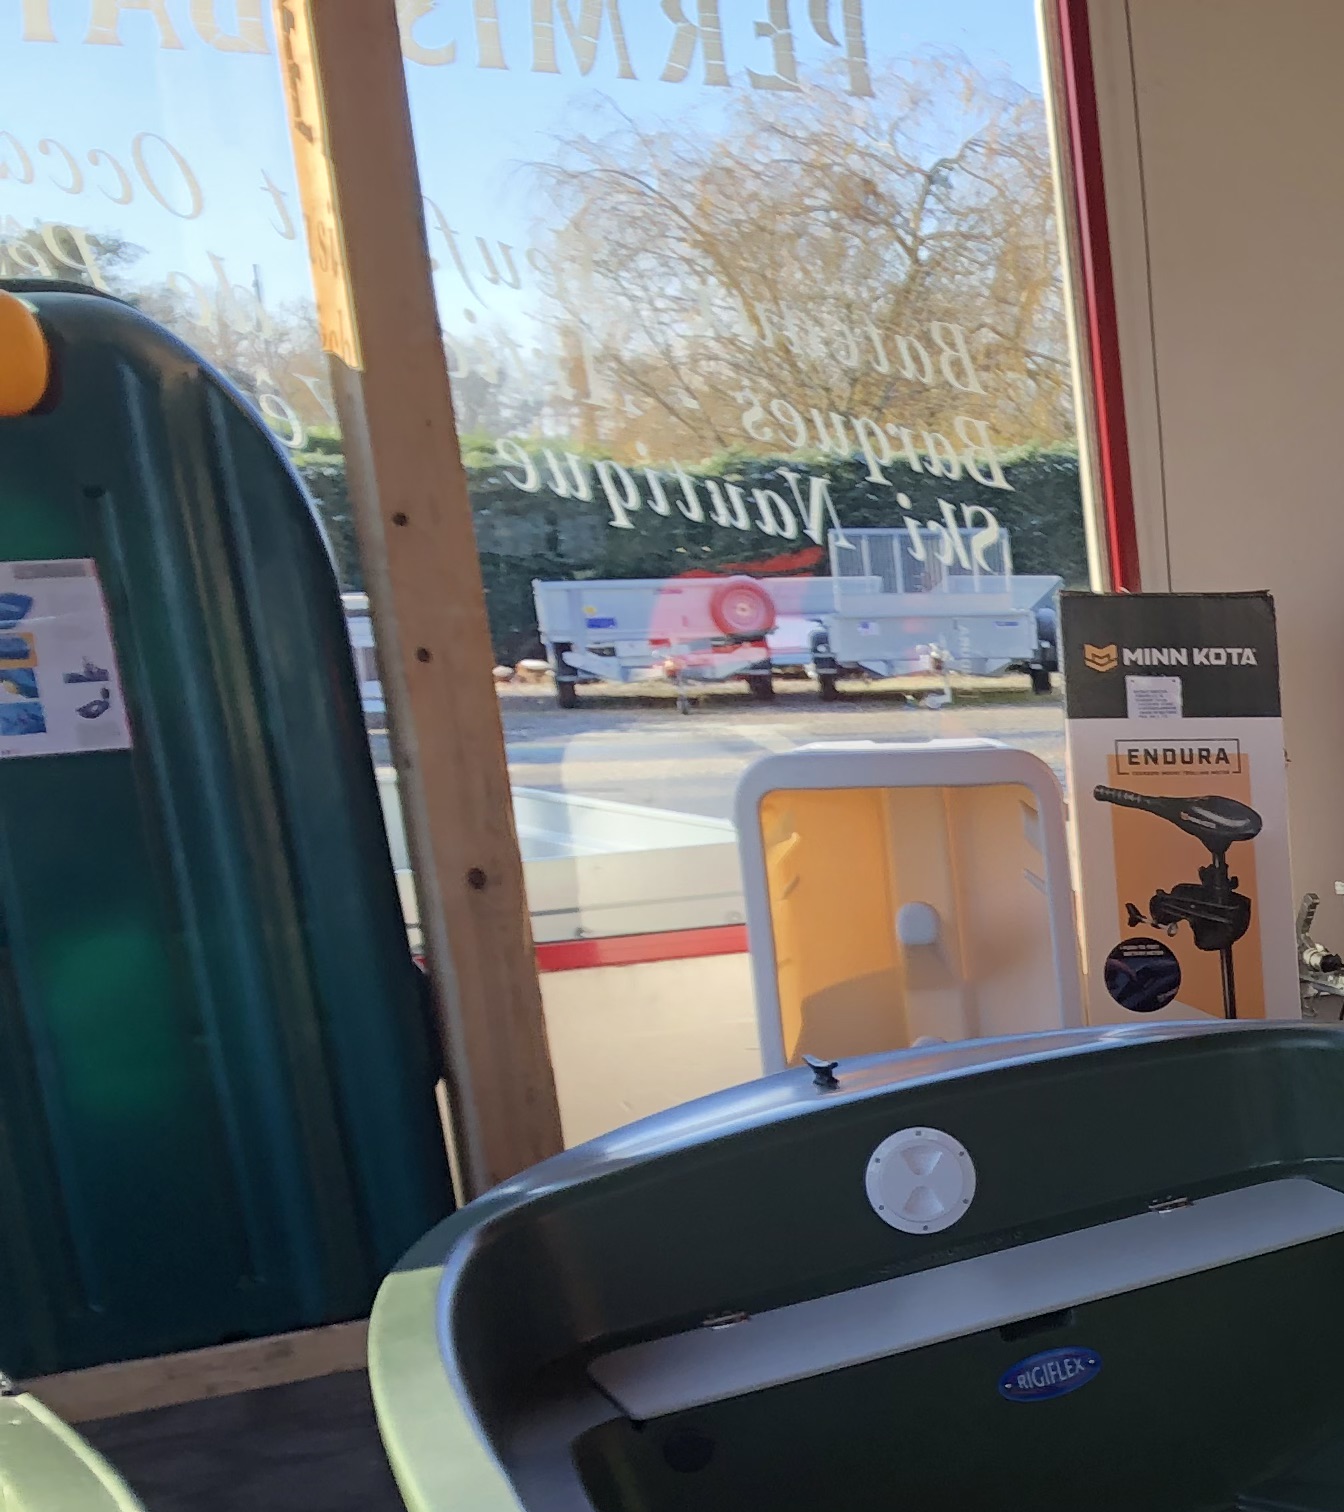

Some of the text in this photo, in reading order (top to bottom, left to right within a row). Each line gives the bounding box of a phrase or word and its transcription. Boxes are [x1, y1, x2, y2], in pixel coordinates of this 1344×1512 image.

[1122, 647, 1258, 666] MINN KOTA
[1127, 747, 1230, 766] ENDURA
[1016, 1357, 1085, 1390] RIGIFLEX
